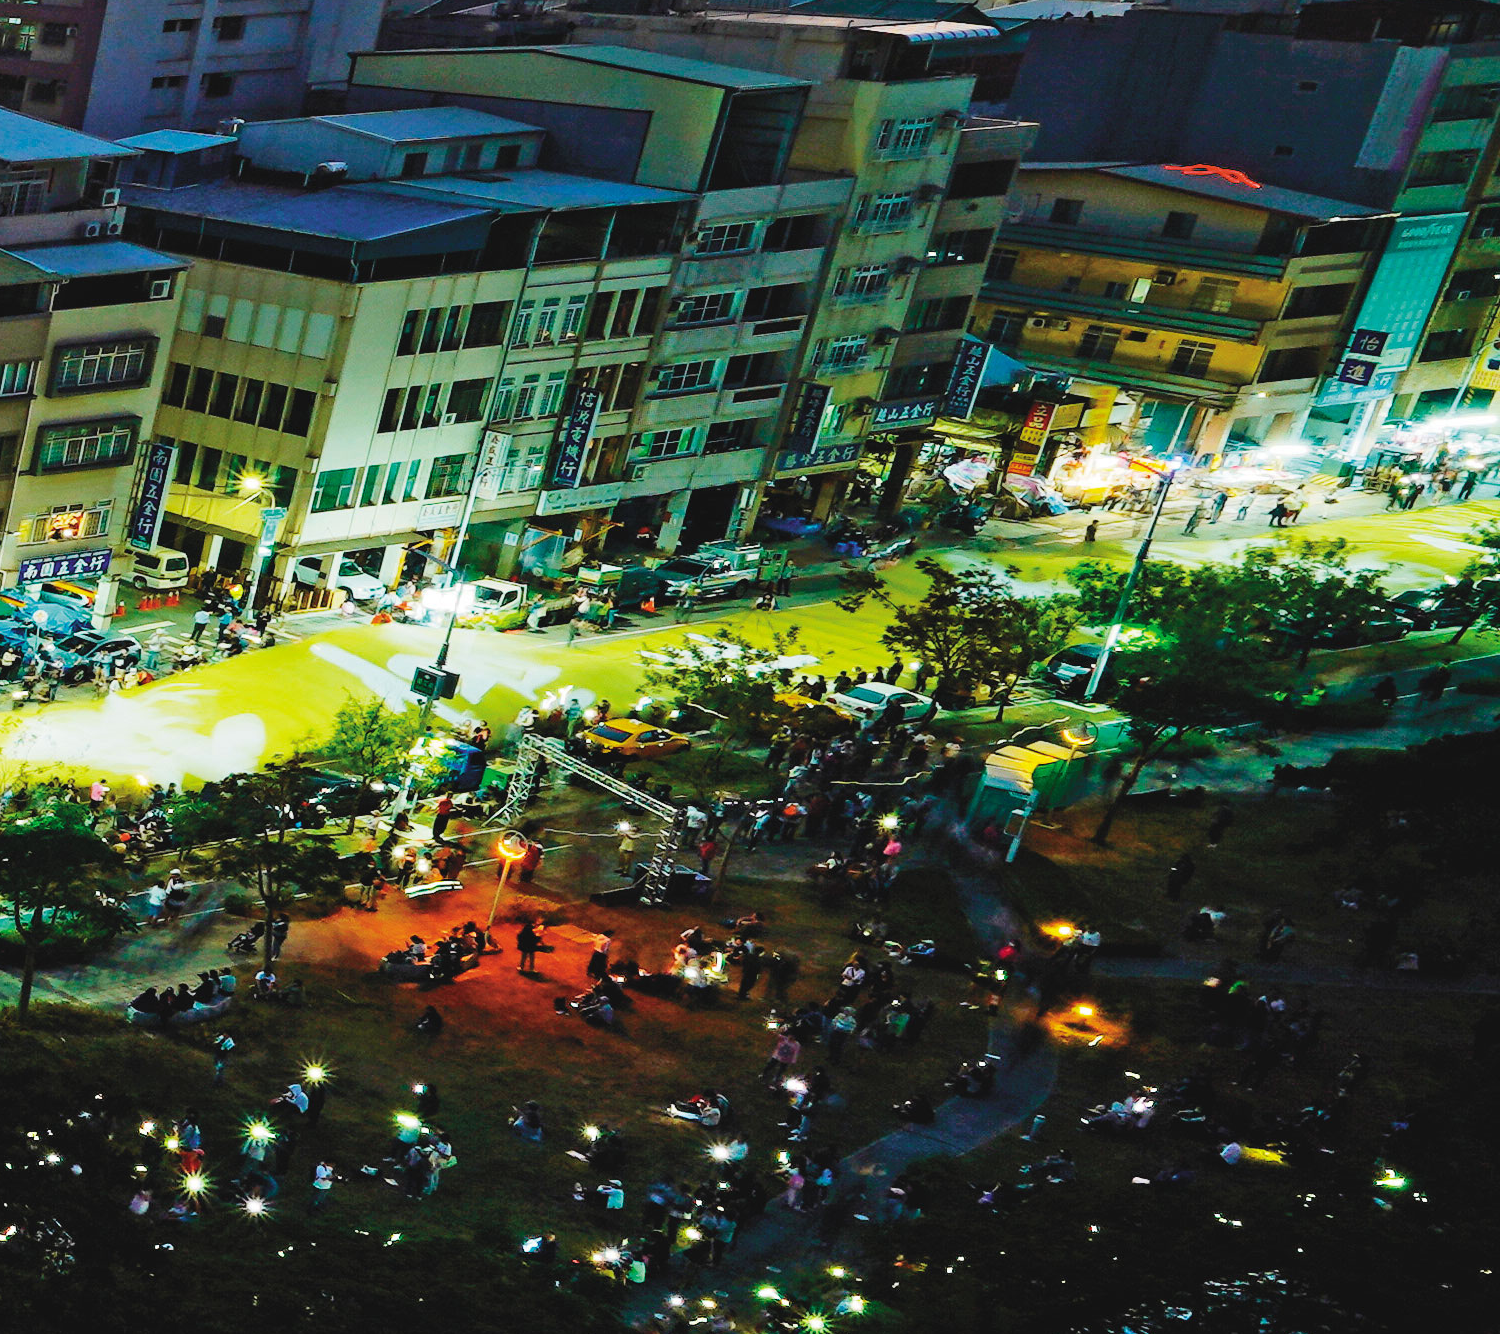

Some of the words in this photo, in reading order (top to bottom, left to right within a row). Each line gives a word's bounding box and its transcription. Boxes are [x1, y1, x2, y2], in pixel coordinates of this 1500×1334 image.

[559, 391, 597, 478] 信源電機行
